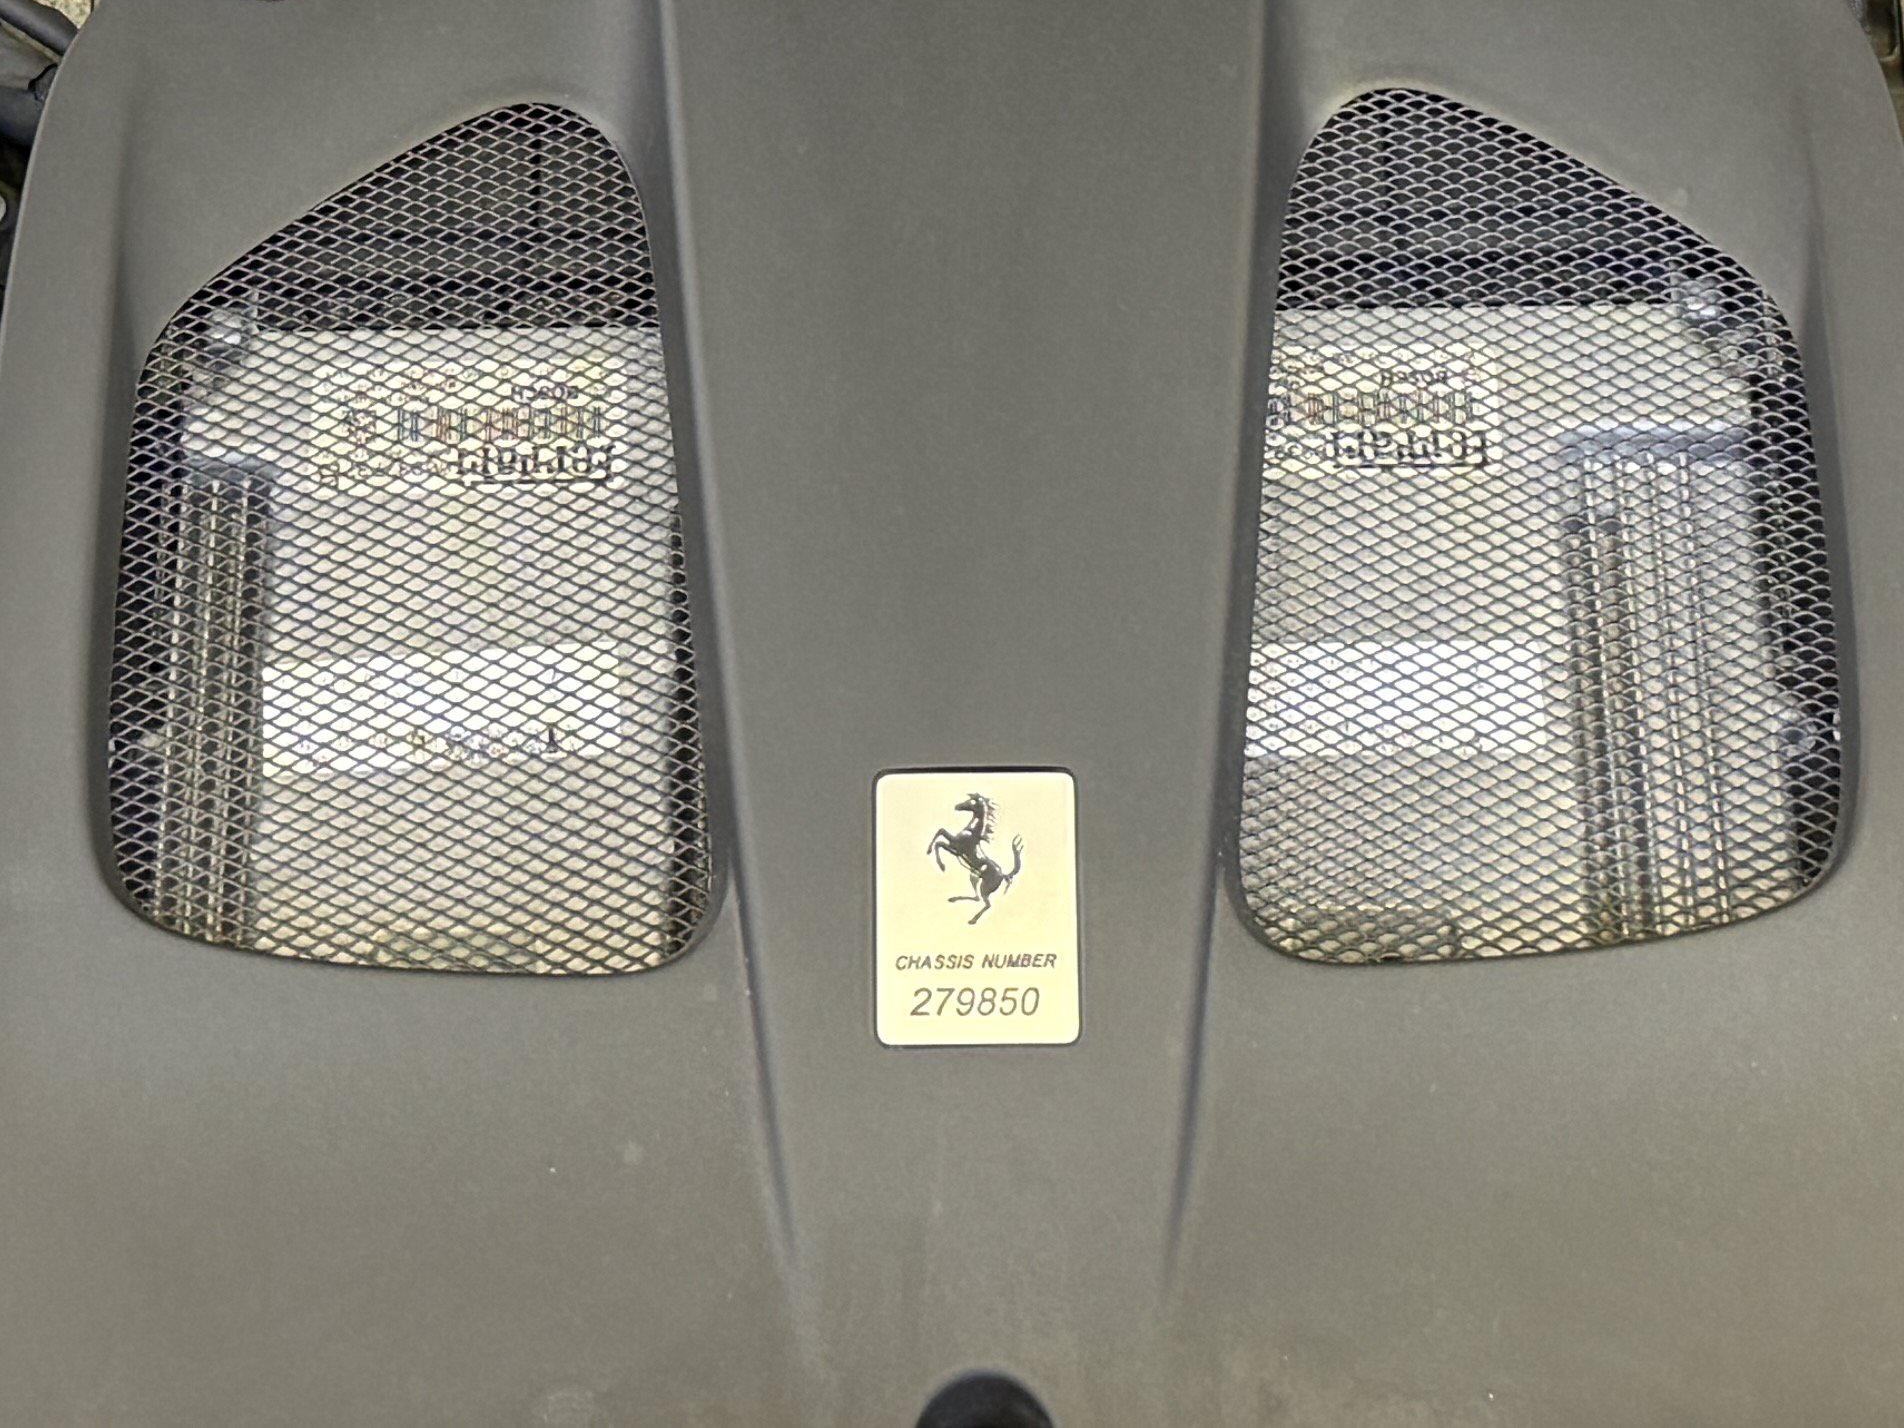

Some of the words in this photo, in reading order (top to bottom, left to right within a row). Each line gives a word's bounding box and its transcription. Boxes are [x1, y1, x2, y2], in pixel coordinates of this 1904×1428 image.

[895, 953, 975, 971] CHASSIS
[981, 953, 1058, 969] NUMBER
[909, 987, 1040, 1017] 279850
